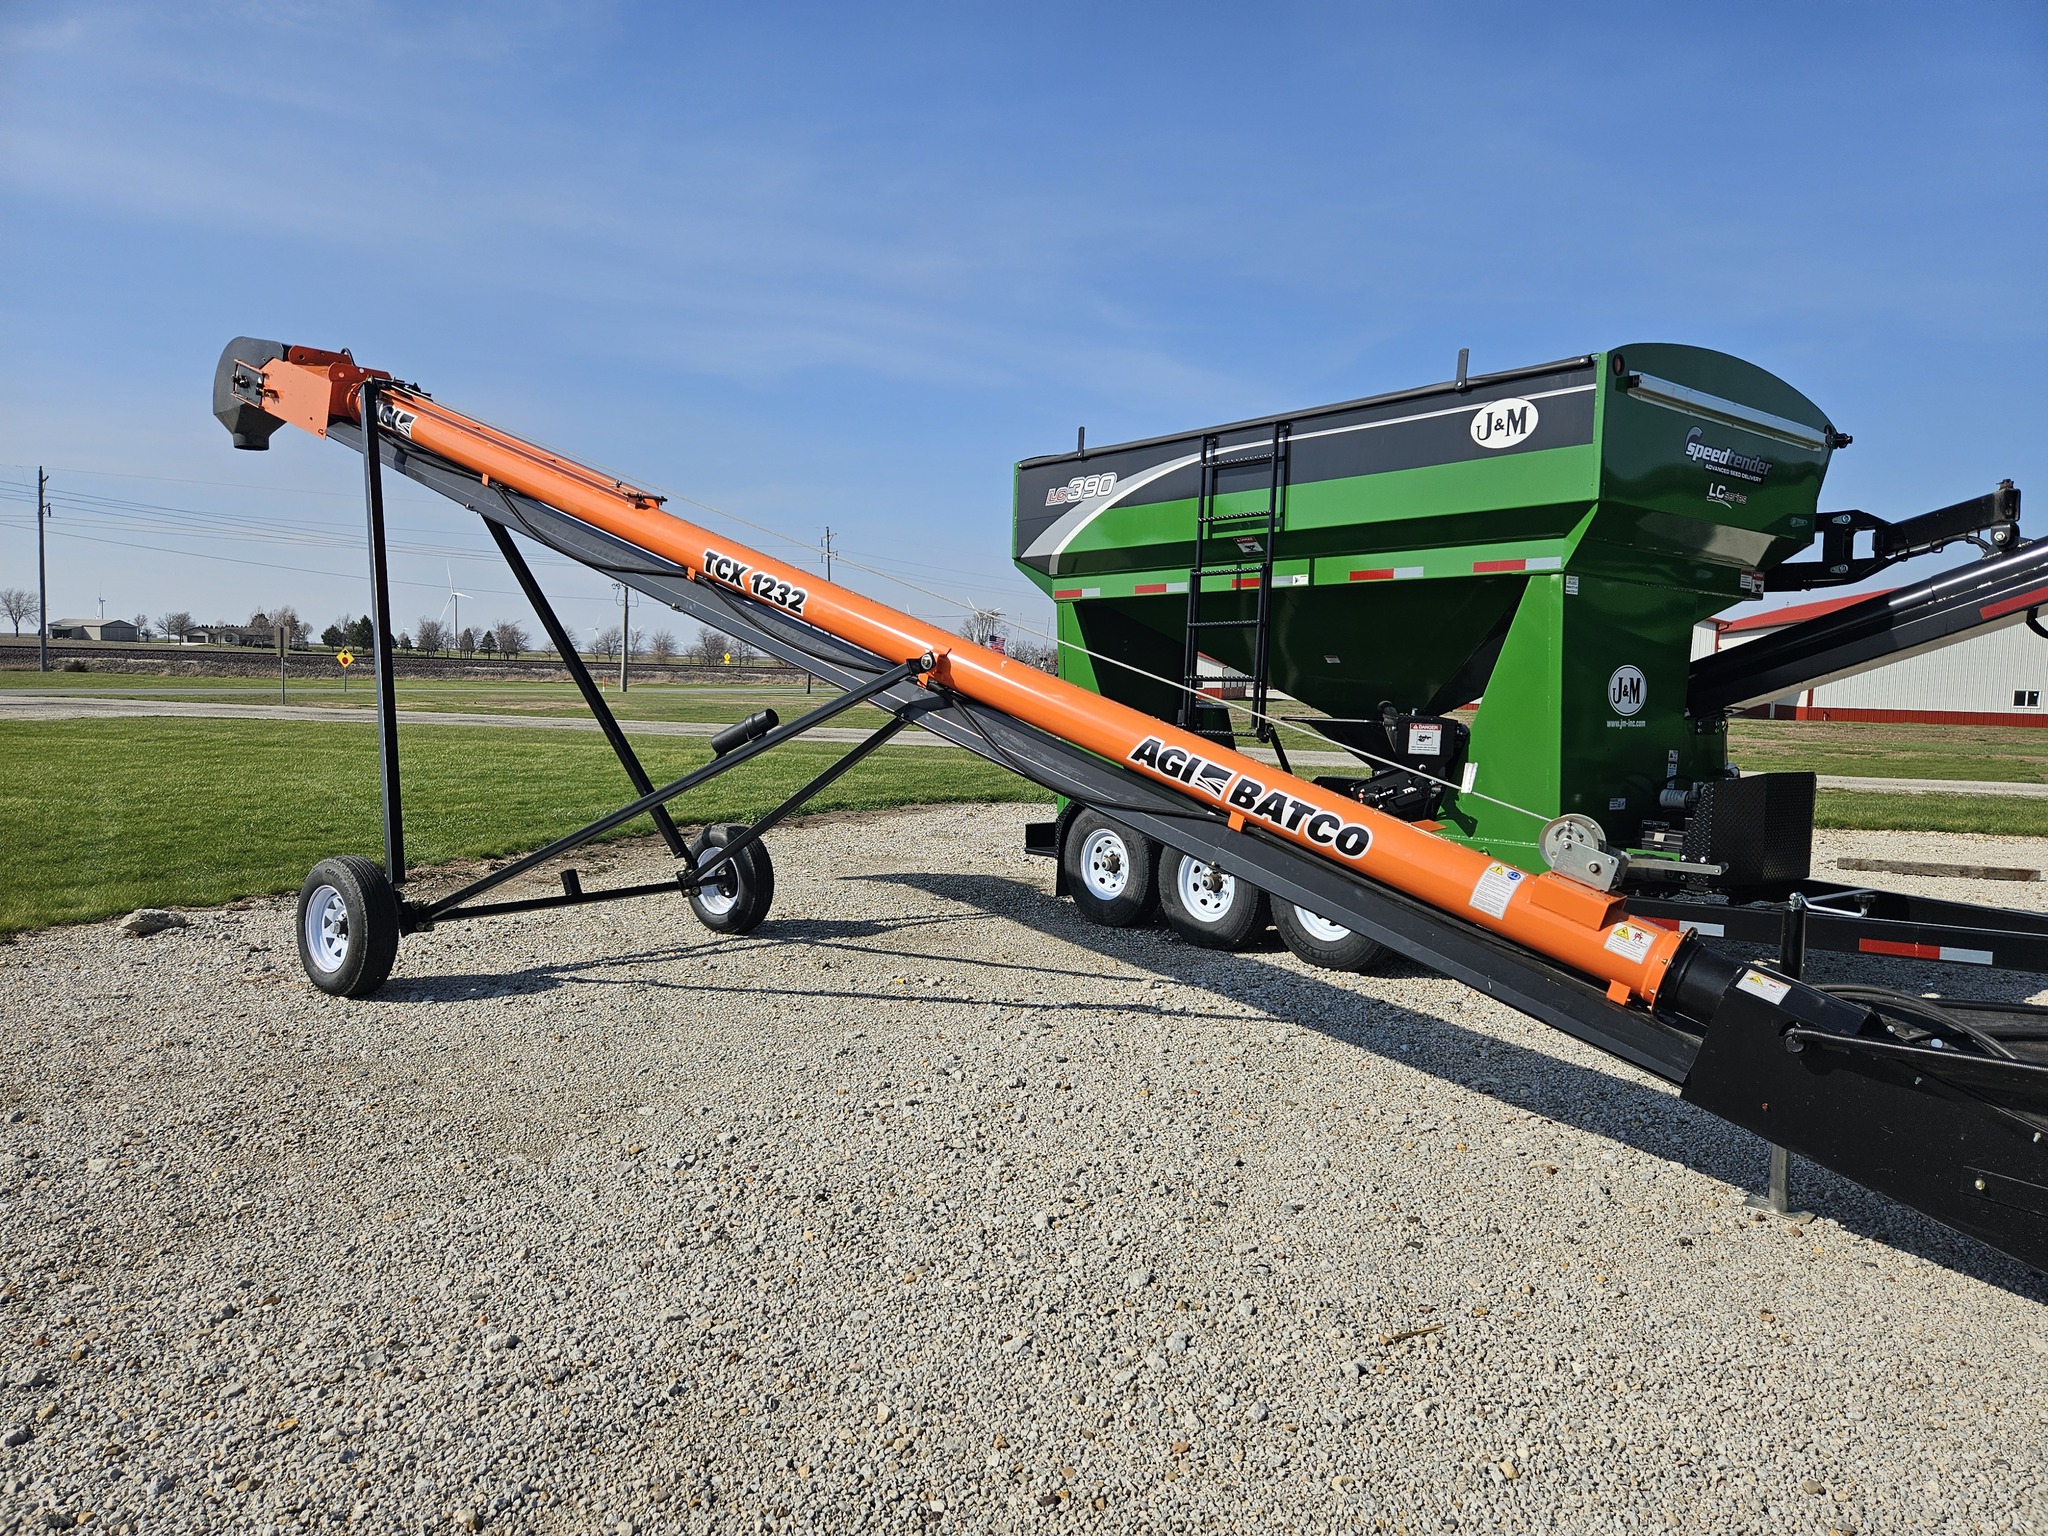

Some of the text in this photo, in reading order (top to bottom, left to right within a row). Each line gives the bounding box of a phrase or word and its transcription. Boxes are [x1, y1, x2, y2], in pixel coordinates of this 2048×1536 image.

[1476, 406, 1528, 441] J&M
[1685, 442, 1772, 474] speedtender
[1705, 463, 1761, 482] ADVANCED SEED DELIVERY
[703, 549, 808, 615] TCX 1232
[1612, 677, 1641, 704] J&M
[1129, 736, 1373, 858] AGI BATCO
